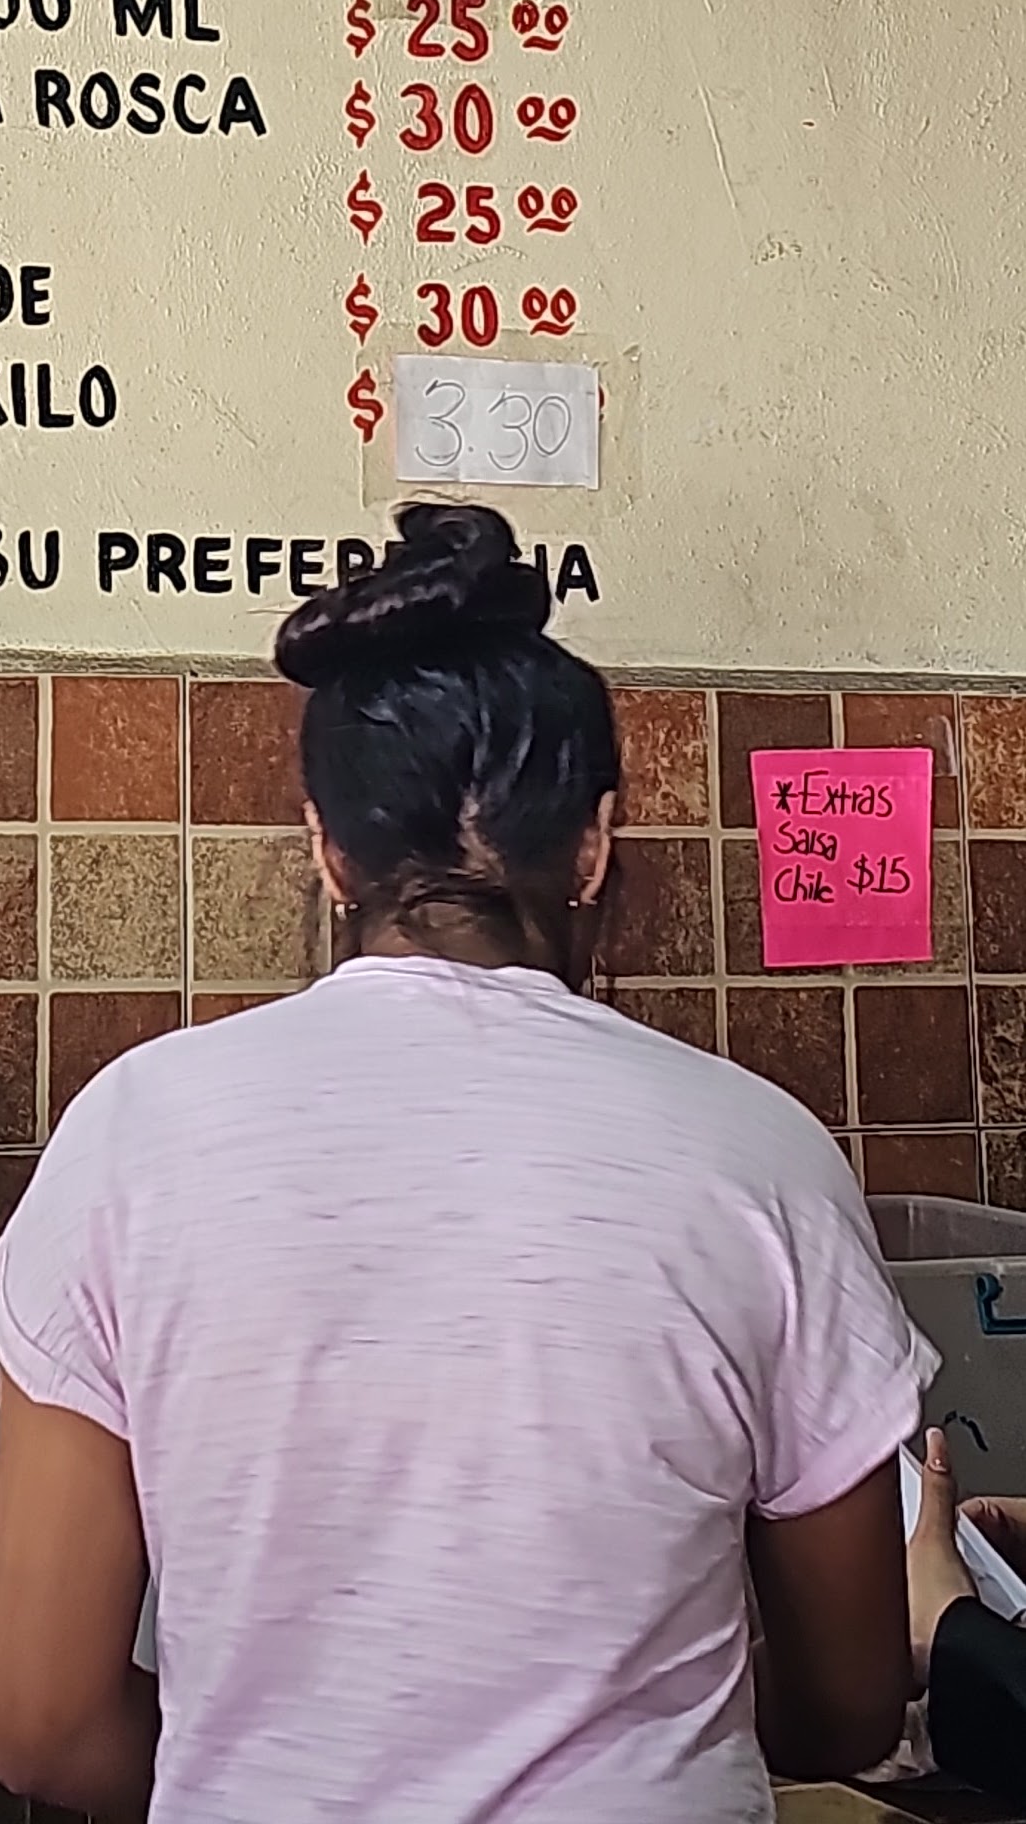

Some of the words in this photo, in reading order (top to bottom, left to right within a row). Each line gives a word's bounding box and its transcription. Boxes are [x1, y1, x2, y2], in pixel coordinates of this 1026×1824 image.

[33, 68, 268, 138] ROSCA
[399, 83, 494, 155] 30
[416, 182, 502, 245] 25
[417, 283, 500, 349] 30
[97, 530, 601, 604] PREFERIA
[846, 853, 911, 895] $15
